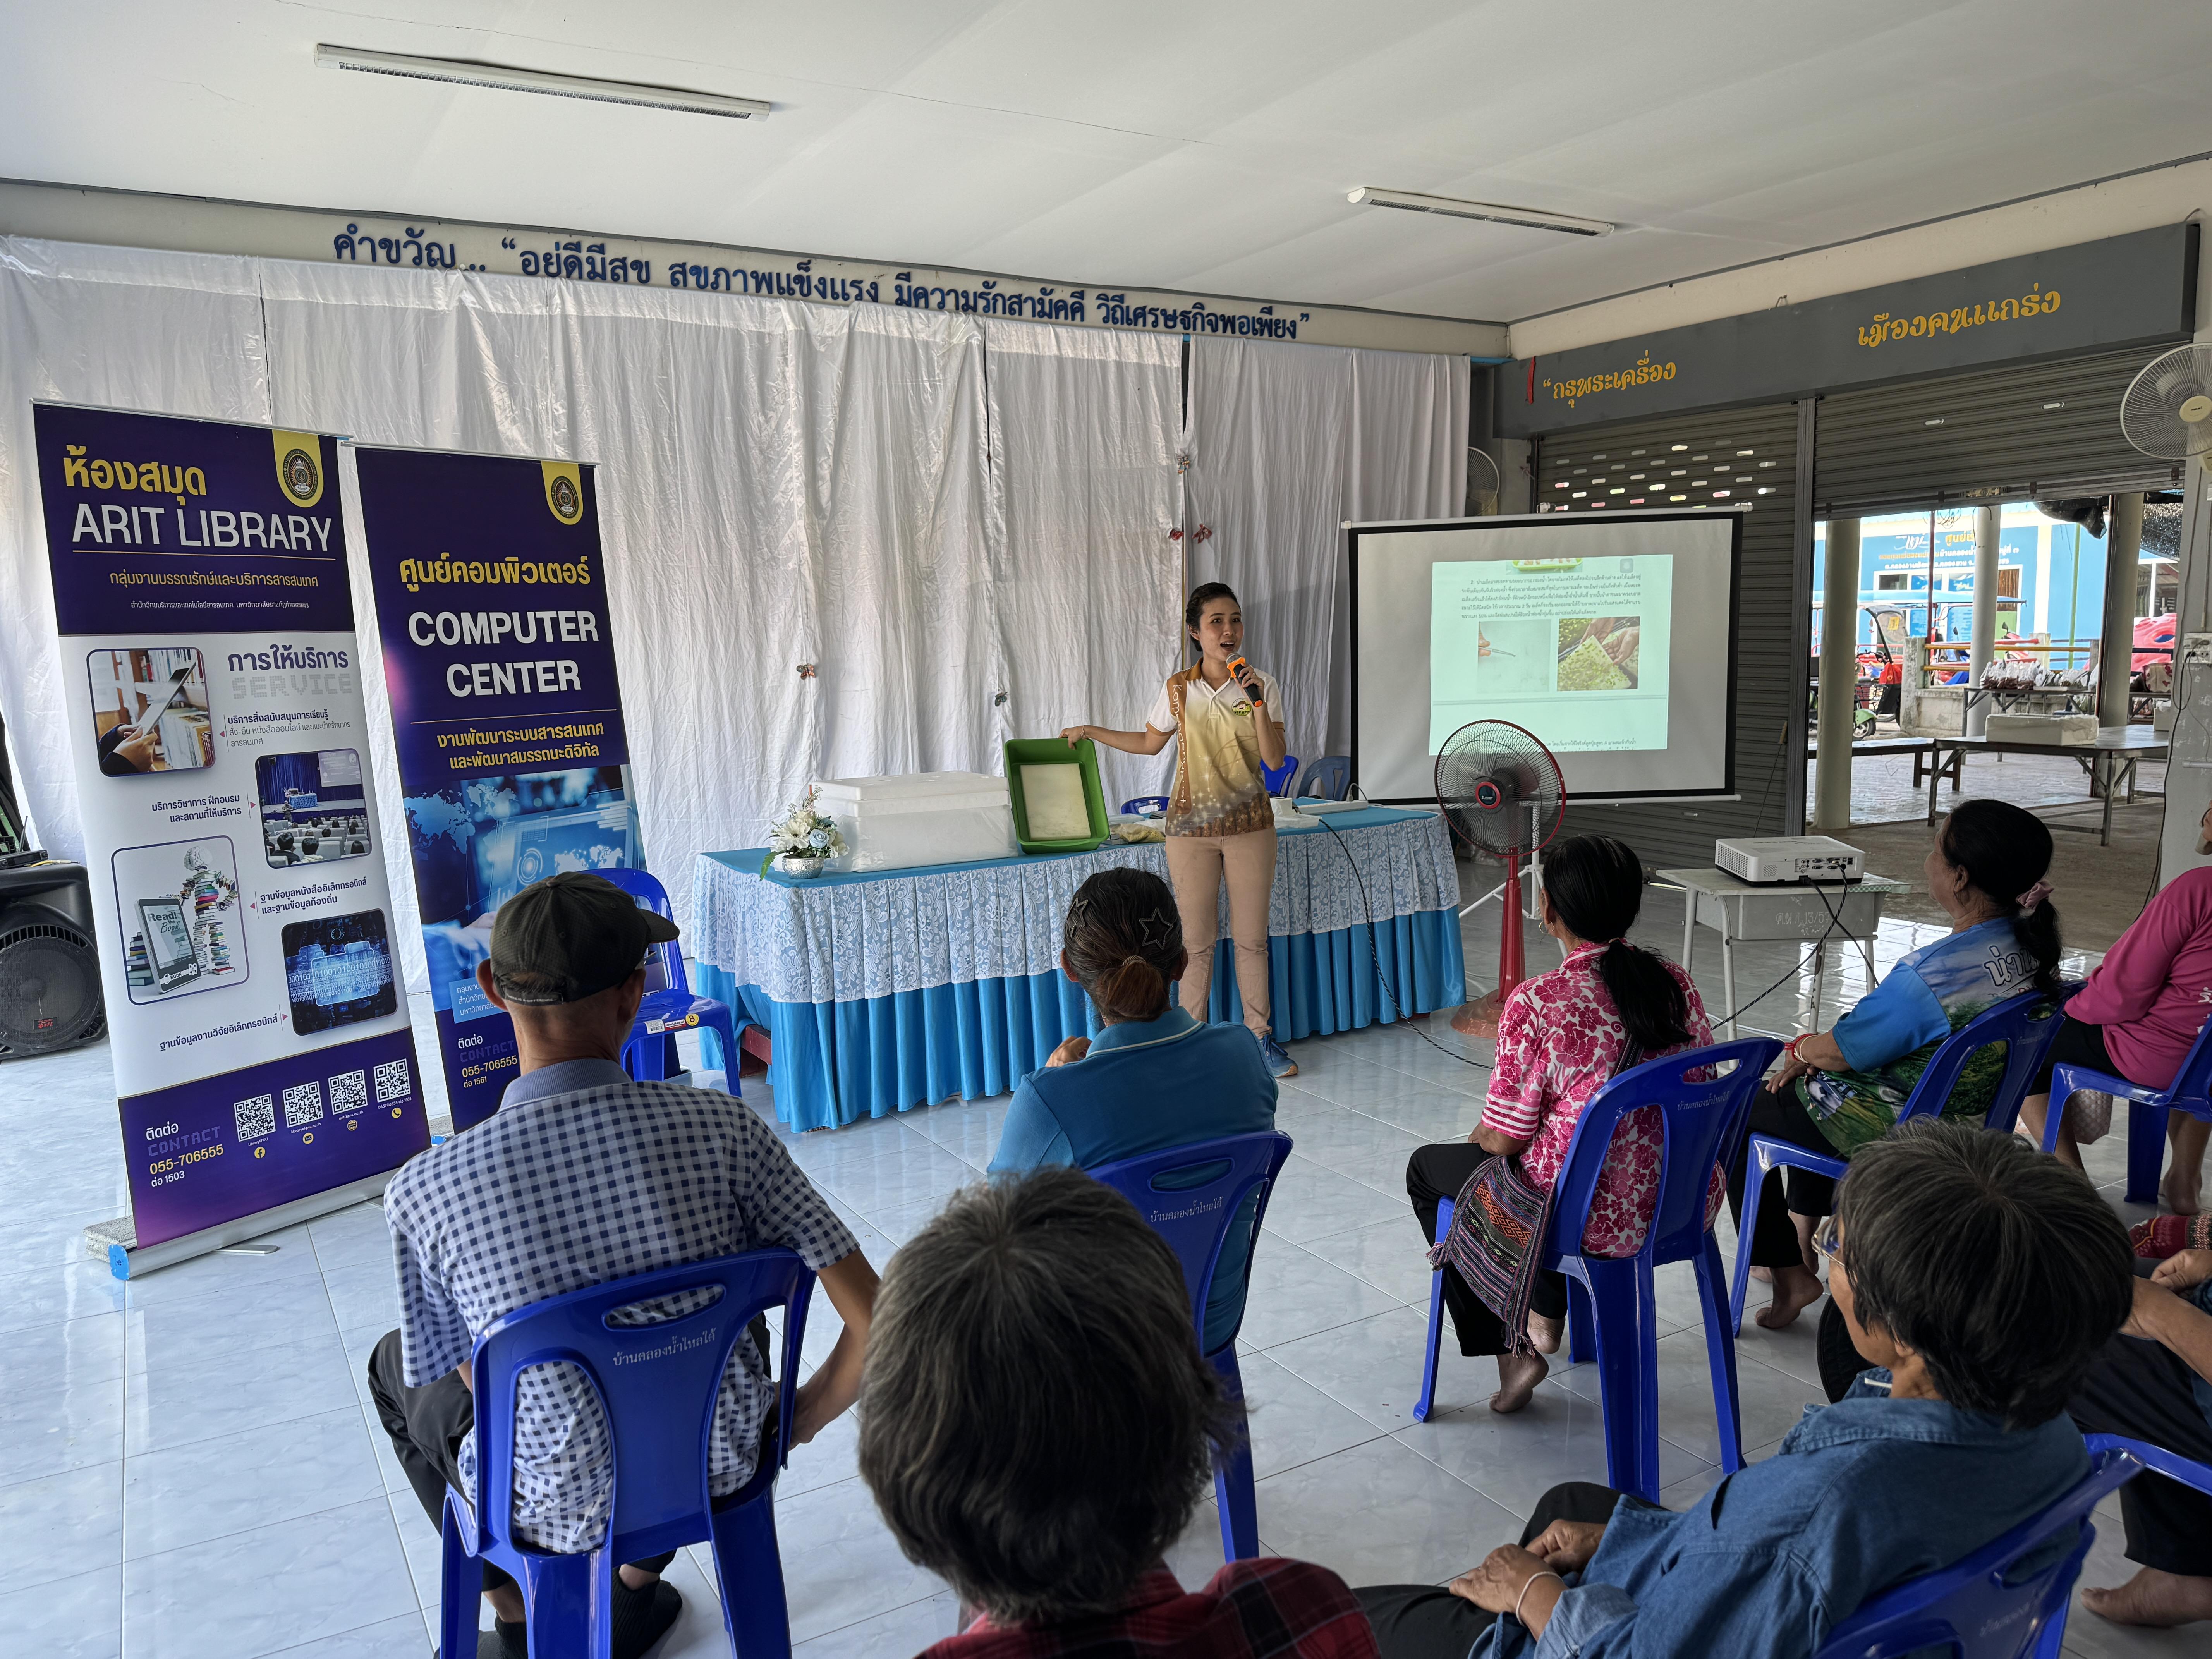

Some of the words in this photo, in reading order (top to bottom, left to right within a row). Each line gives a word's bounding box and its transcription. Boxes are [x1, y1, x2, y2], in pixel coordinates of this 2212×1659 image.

[894, 272, 1085, 322] มีความรักสามัคคี
[1858, 282, 2061, 347] เมืองคนแกร่ง
[63, 445, 207, 506] ห้องสมุด
[72, 503, 165, 545] ARIT
[177, 508, 332, 552] LIBRARY
[110, 569, 319, 588] กลุ่มงานบรรณรักษ์และบริการสารสนเทศ
[399, 552, 591, 592] ศูนย์คอมพิวเตอร์
[408, 610, 599, 646] COMPUTER
[228, 644, 349, 672] การให้บริการ
[232, 673, 352, 699] SERVICE
[446, 659, 582, 697] CENTER
[231, 737, 263, 747] สารสนเทศ
[437, 722, 605, 748] งานพัฒนาระบบสารสนเทศ
[449, 744, 599, 769] และพัฒนาสมรรถนะดิจิทัล
[151, 797, 207, 812] บริการวิชาการ
[208, 794, 240, 807] ฝึกอบรม
[169, 806, 242, 823] และสถานที่ให้บริการ
[260, 876, 367, 904] ฐานข้อมูลหนังสืออิเล็กทรอนิกส์
[147, 911, 177, 922] Read!
[261, 895, 338, 914] และฐานข้อมูลท้องถิ่น
[161, 921, 180, 933] Book
[1984, 945, 2041, 987] น่าน
[159, 1013, 278, 1052] ฐานข้อมูลงานวิจัยอิเล็กทรอนิกส์
[458, 1034, 483, 1049] ติดต่อ
[460, 1040, 514, 1063] CONTACT
[462, 1055, 518, 1078] 055-706555
[464, 1079, 472, 1088] ต่อ
[474, 1076, 487, 1085] 1561
[145, 1120, 179, 1141] ติดต่อ
[148, 1125, 221, 1157] CONTACT
[149, 1144, 224, 1175] 055-706555
[151, 1176, 163, 1188] ต่อ
[165, 1170, 185, 1184] 1503
[1150, 1196, 1223, 1223] บ้านคลองน้ำไหลใต้
[613, 1327, 716, 1366] บ้านคลองน้ำไหลใต้
